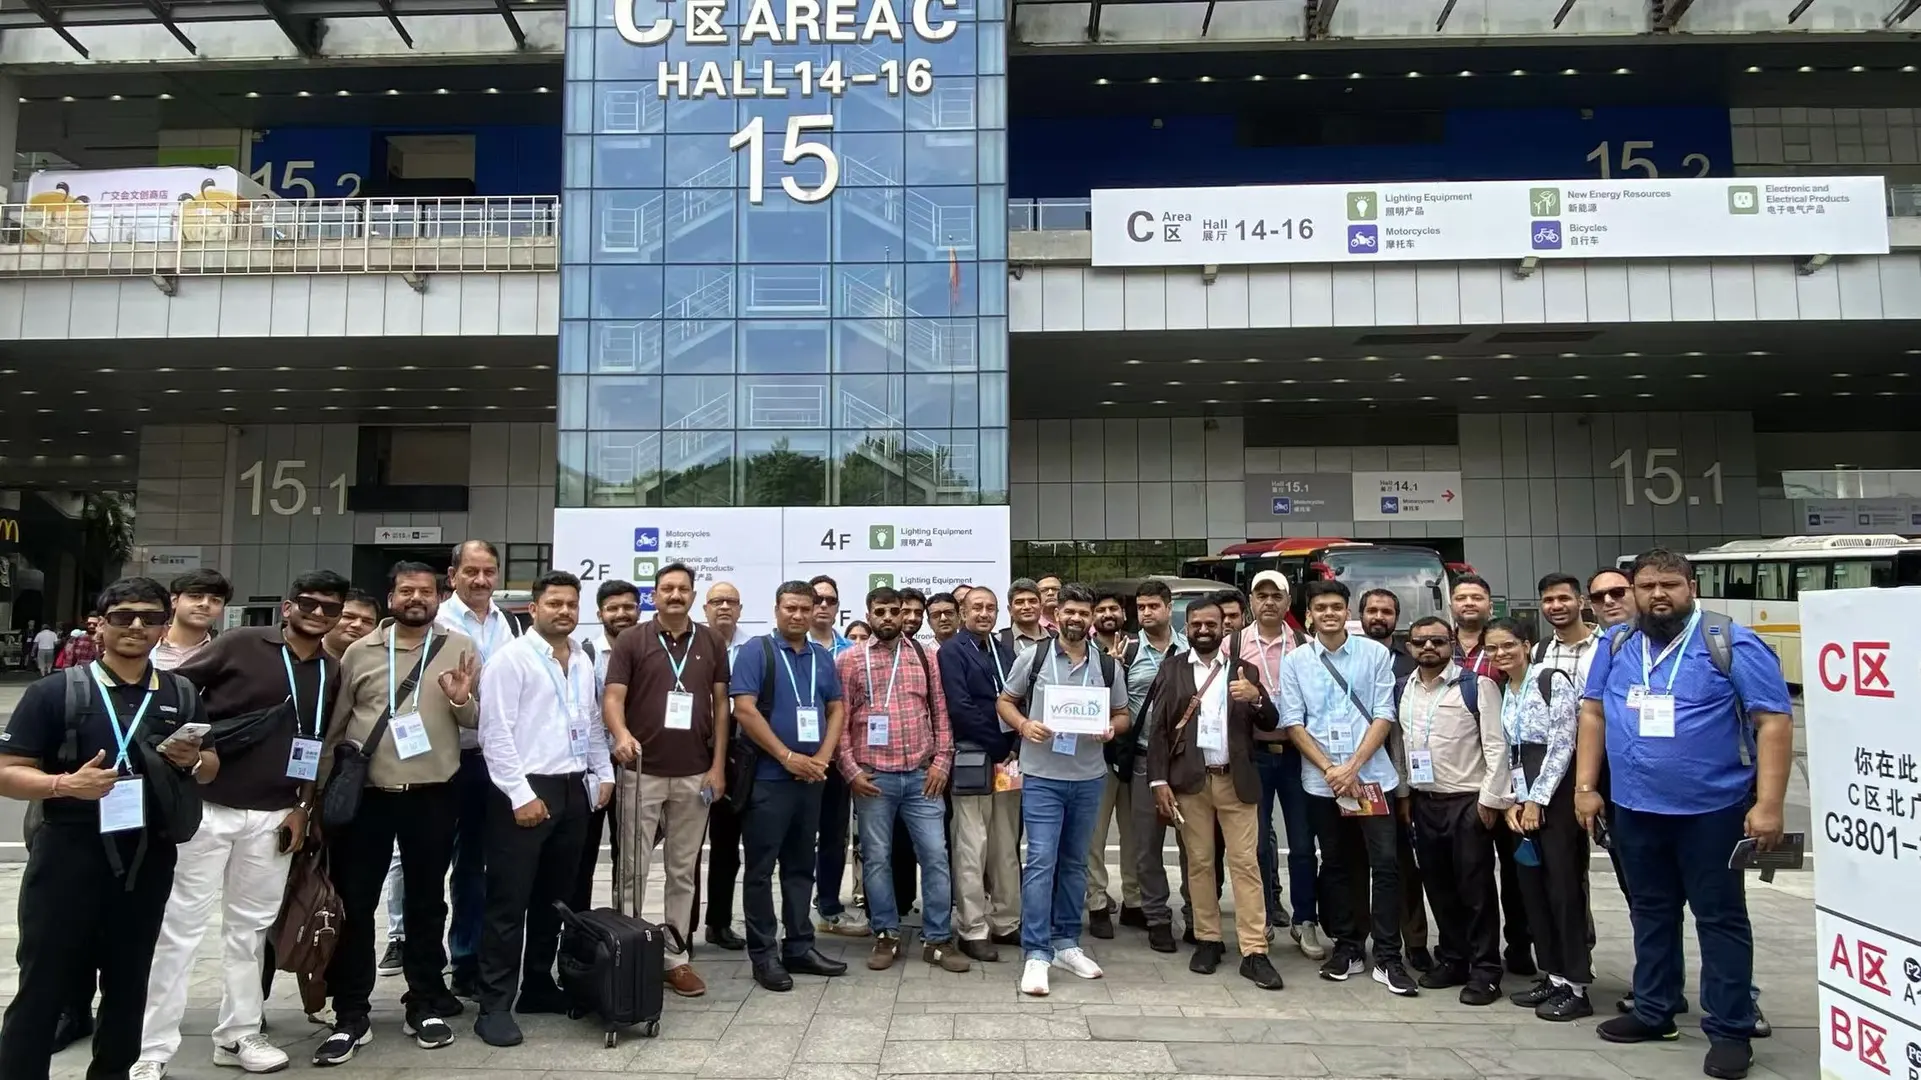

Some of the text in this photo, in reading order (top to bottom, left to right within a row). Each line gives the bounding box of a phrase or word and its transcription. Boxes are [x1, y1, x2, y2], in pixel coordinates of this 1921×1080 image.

[740, 0, 904, 43] AREA
[911, 0, 958, 42] C
[656, 57, 934, 98] HALL 14-16
[728, 113, 841, 205] 15
[1567, 189, 1672, 200] New Energy Resources
[1765, 184, 1830, 193] Electronic and
[1385, 192, 1473, 204] Lighting Equipment
[1766, 194, 1850, 204] Electrical Products
[1385, 206, 1425, 217] 照明产品
[1568, 202, 1598, 213] 新能源
[1767, 204, 1826, 215] 电子电气产品
[1161, 211, 1193, 222] Area
[1126, 210, 1155, 243] C
[1202, 218, 1229, 230] Hall
[1234, 217, 1315, 241] 14-16
[1569, 223, 1608, 234] Bicycles
[1163, 223, 1183, 243] 区
[1202, 230, 1229, 242] 展厅
[1385, 227, 1441, 237] Motorcycles
[1385, 239, 1415, 249] 摩托车
[1570, 235, 1600, 246] 自行车
[1610, 448, 1724, 506] 15.1
[240, 460, 347, 516] 15.1
[1285, 481, 1309, 493] 15.1
[1393, 480, 1418, 492] 14.1
[665, 529, 711, 539] Motorcycles
[900, 527, 973, 537] Lighting Equipment
[820, 528, 852, 550] 4F
[580, 558, 611, 581] 2F
[700, 564, 735, 572] Products
[900, 576, 973, 585] Lighting Equipment
[839, 609, 852, 627] F
[1818, 641, 1896, 699] C区
[1854, 746, 1919, 784] 你在此
[1825, 811, 1921, 860] C3801-
[1829, 932, 1892, 997] A区
[1830, 1004, 1892, 1076] B区
